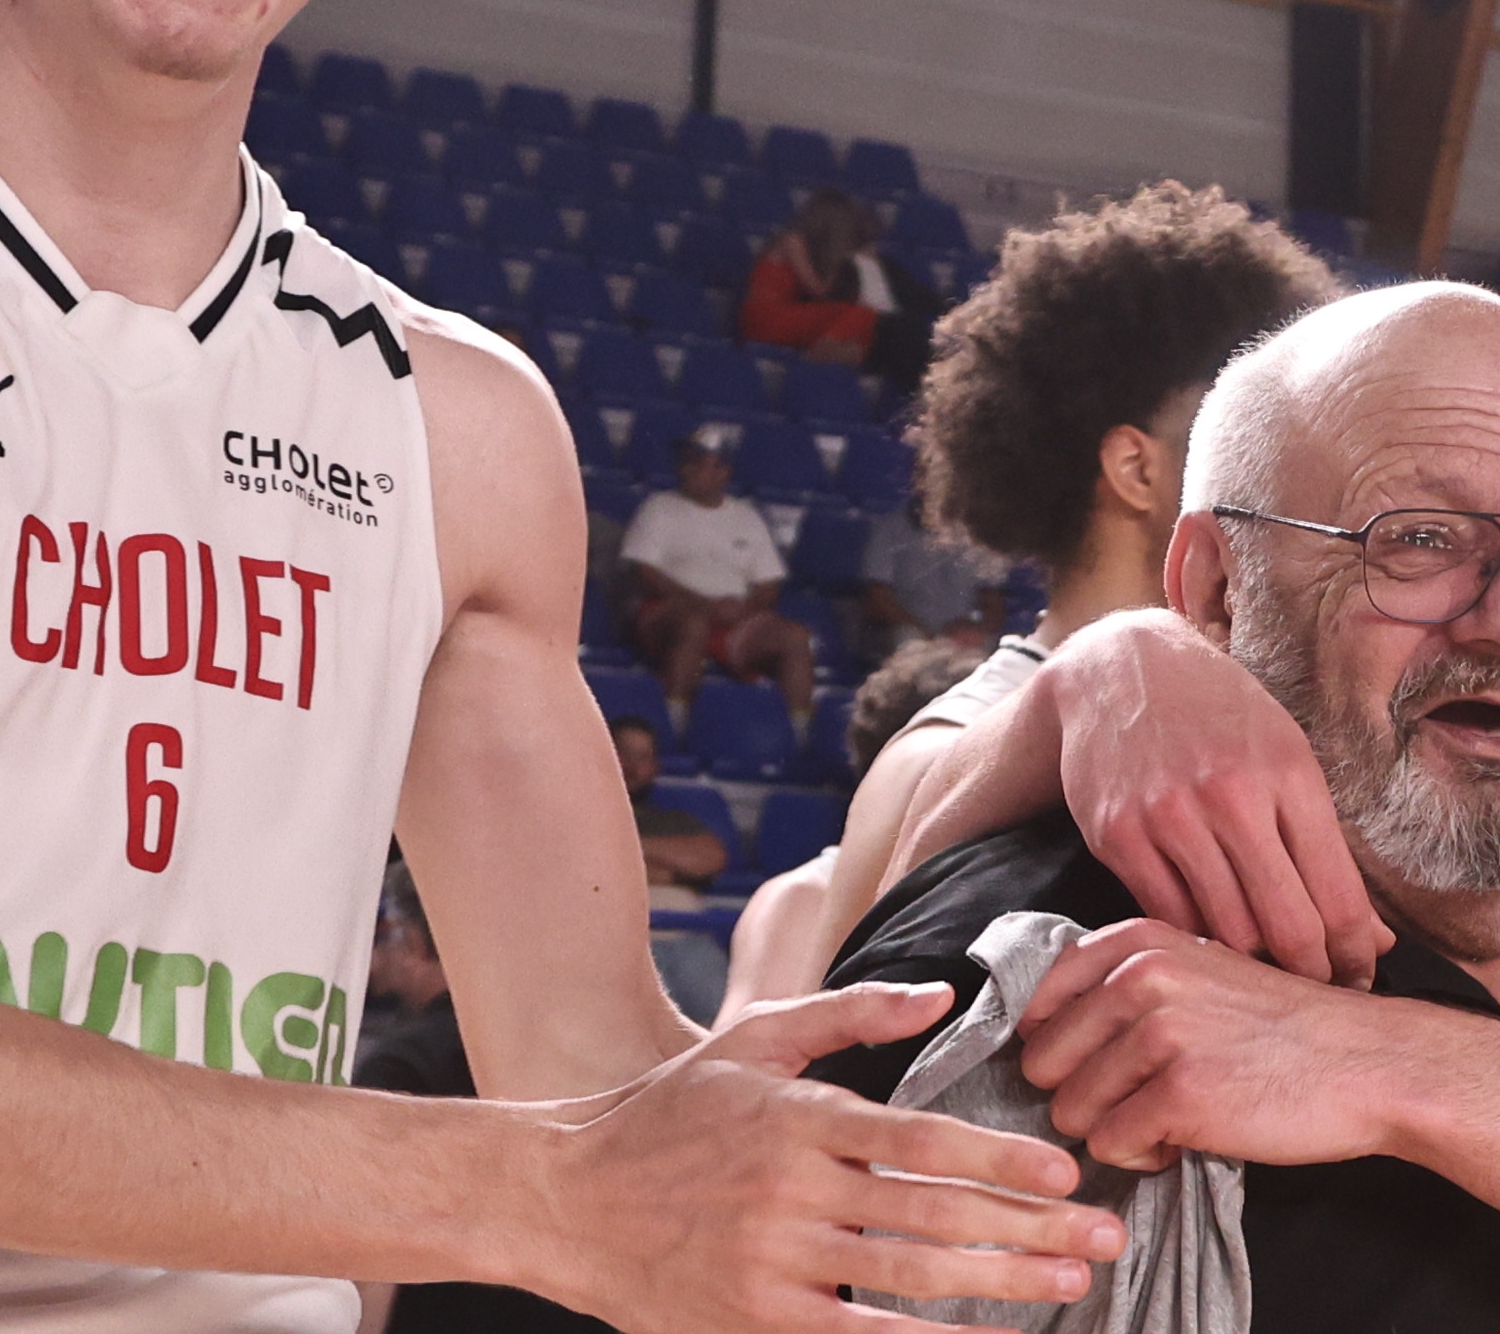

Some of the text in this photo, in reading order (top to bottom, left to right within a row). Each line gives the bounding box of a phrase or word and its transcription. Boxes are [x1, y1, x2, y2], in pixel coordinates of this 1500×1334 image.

[224, 468, 379, 528] agglomération
[9, 514, 331, 711] CHOLET
[125, 722, 184, 874] 6
